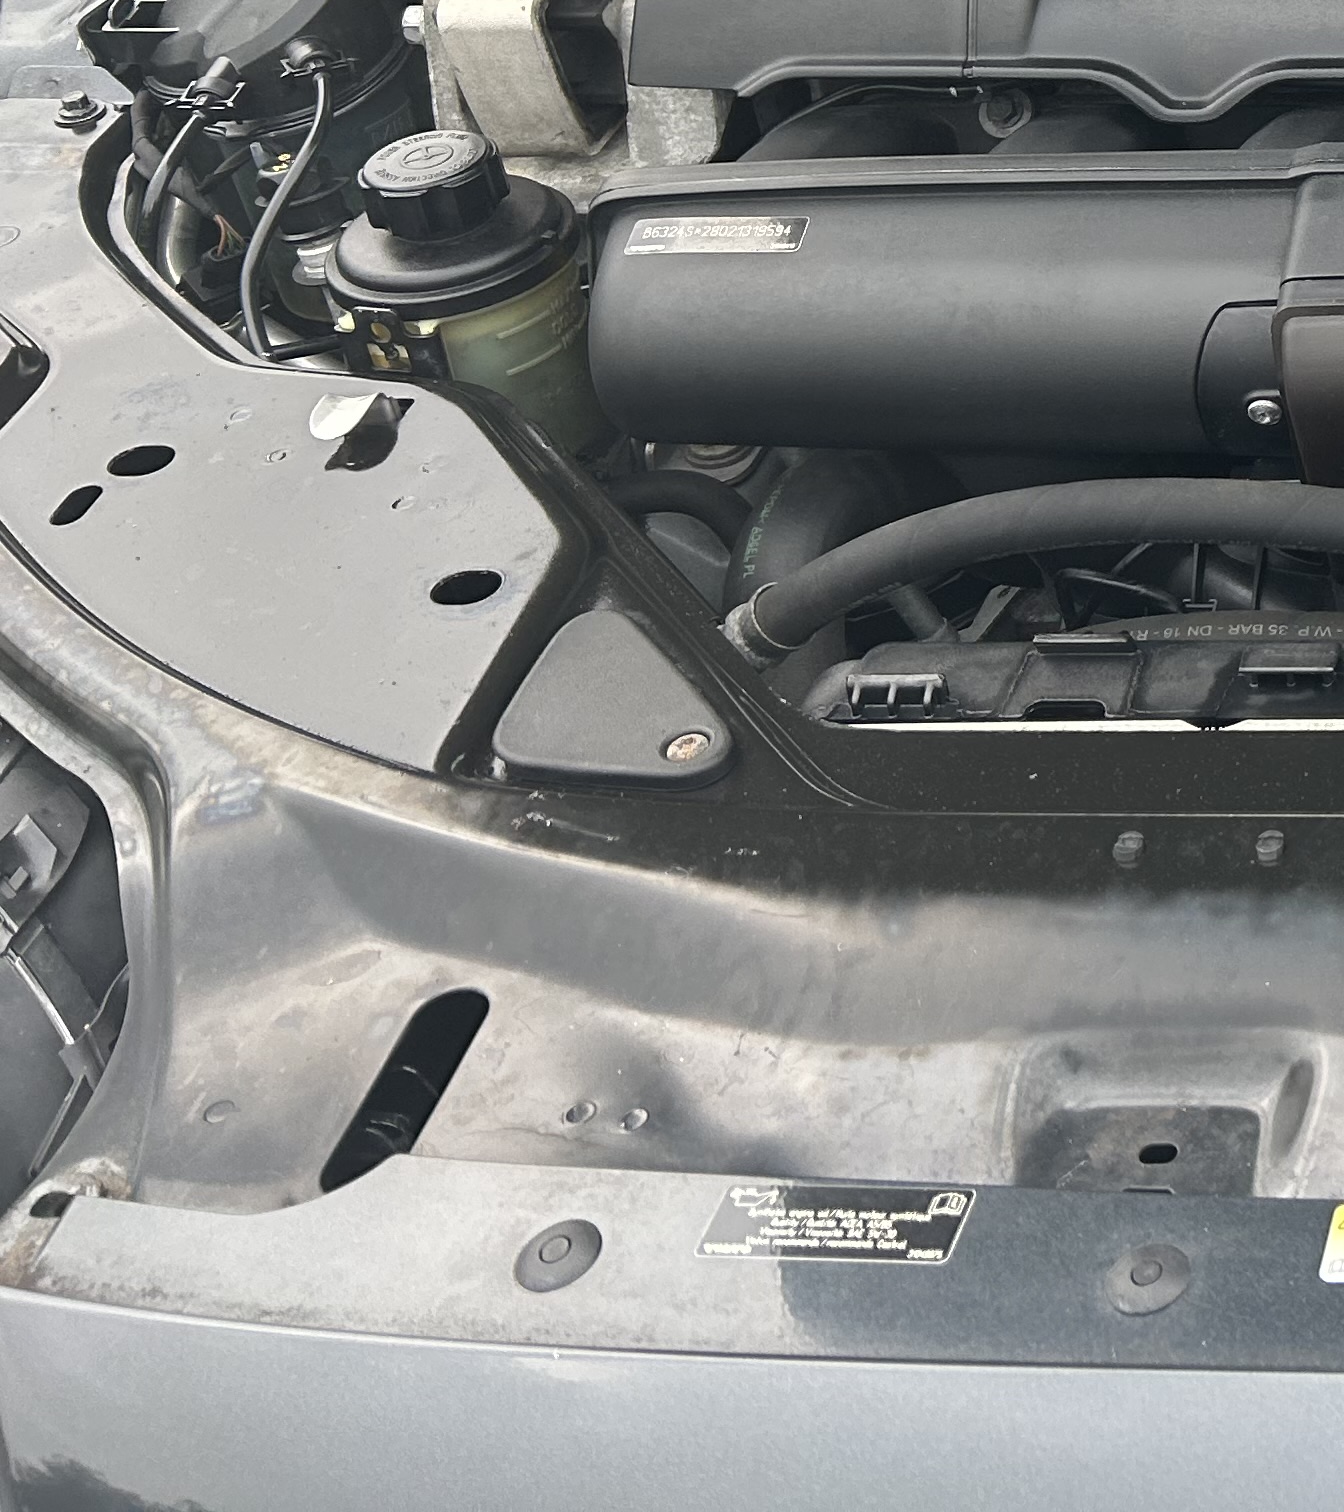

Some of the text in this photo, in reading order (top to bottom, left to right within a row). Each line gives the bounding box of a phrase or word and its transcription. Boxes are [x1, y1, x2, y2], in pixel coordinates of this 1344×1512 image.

[1186, 624, 1212, 637] DN
[1227, 623, 1263, 636] BAR
[1268, 624, 1289, 636] 35
